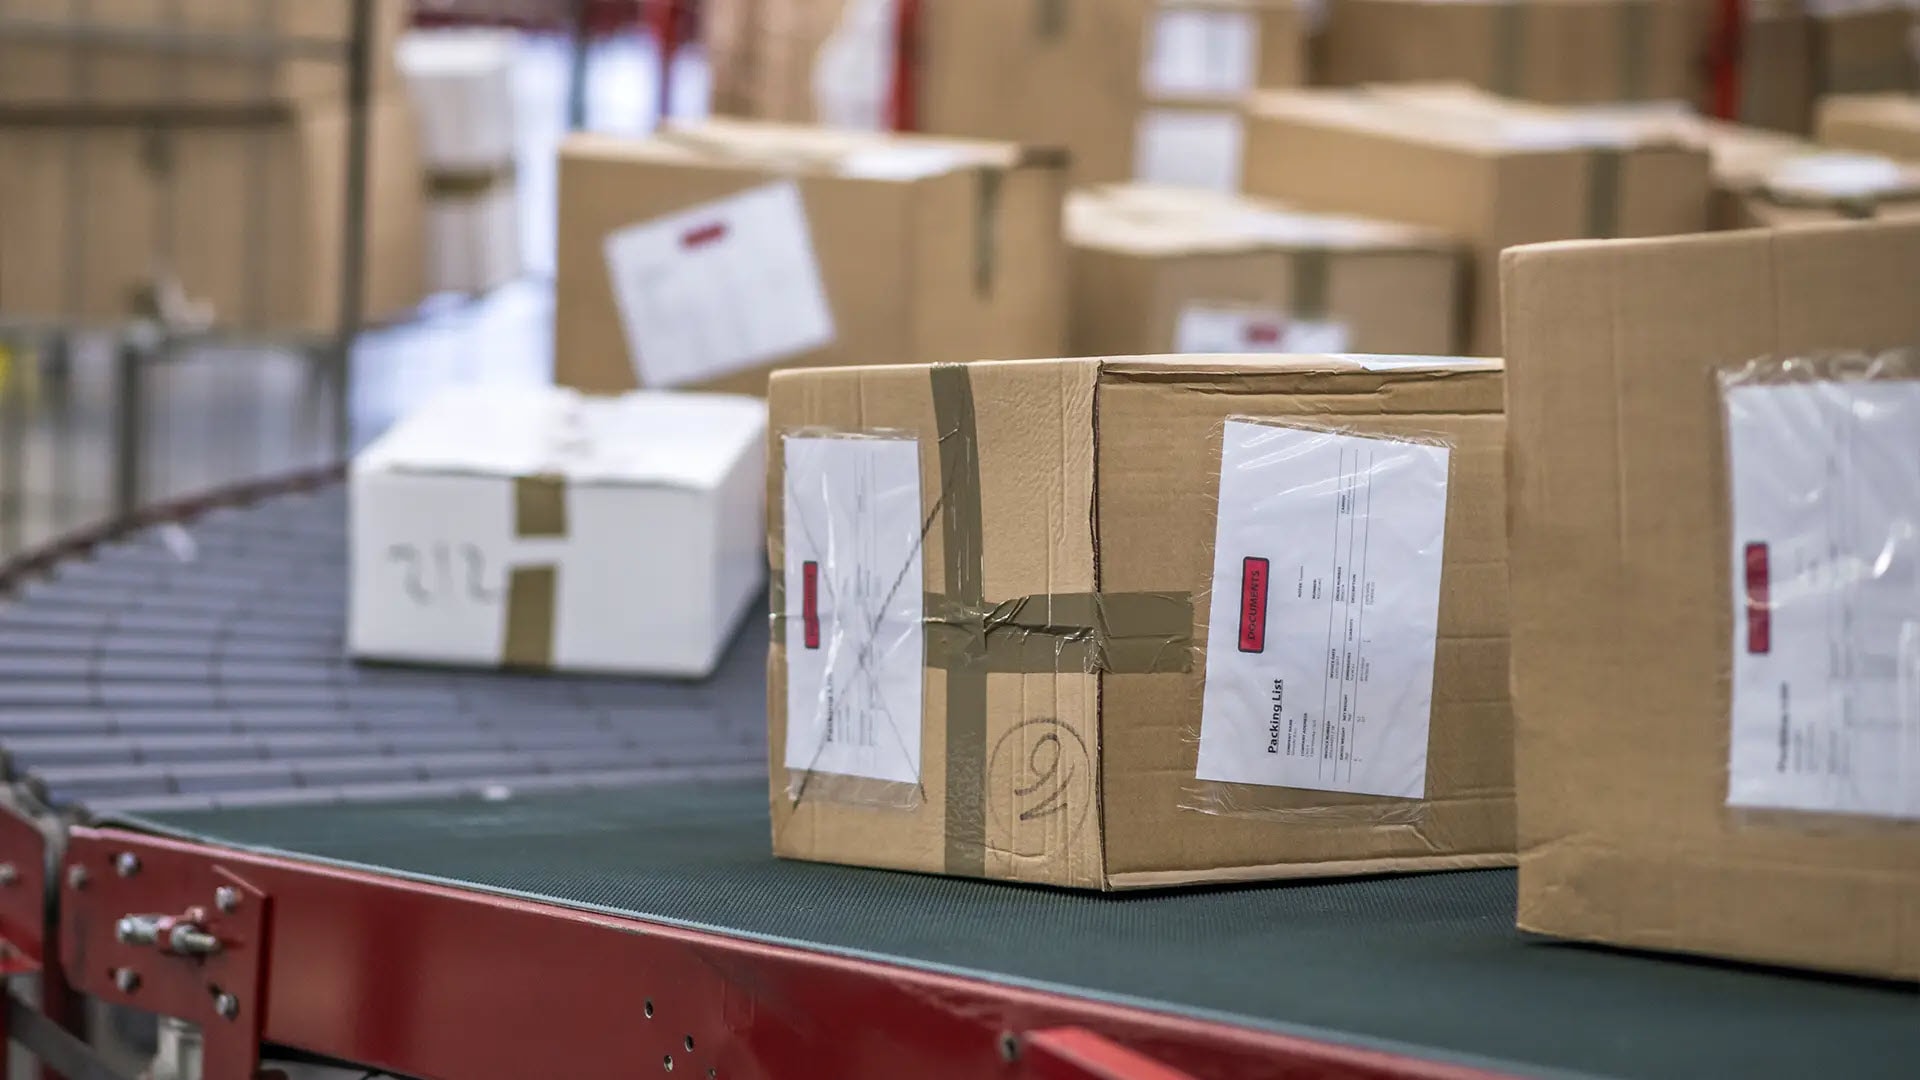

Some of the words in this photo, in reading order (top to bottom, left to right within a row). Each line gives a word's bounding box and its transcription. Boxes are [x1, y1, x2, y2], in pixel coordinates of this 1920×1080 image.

[1246, 569, 1261, 641] DOCUMENTS
[1272, 678, 1283, 701] List
[1267, 704, 1283, 754] Packing
